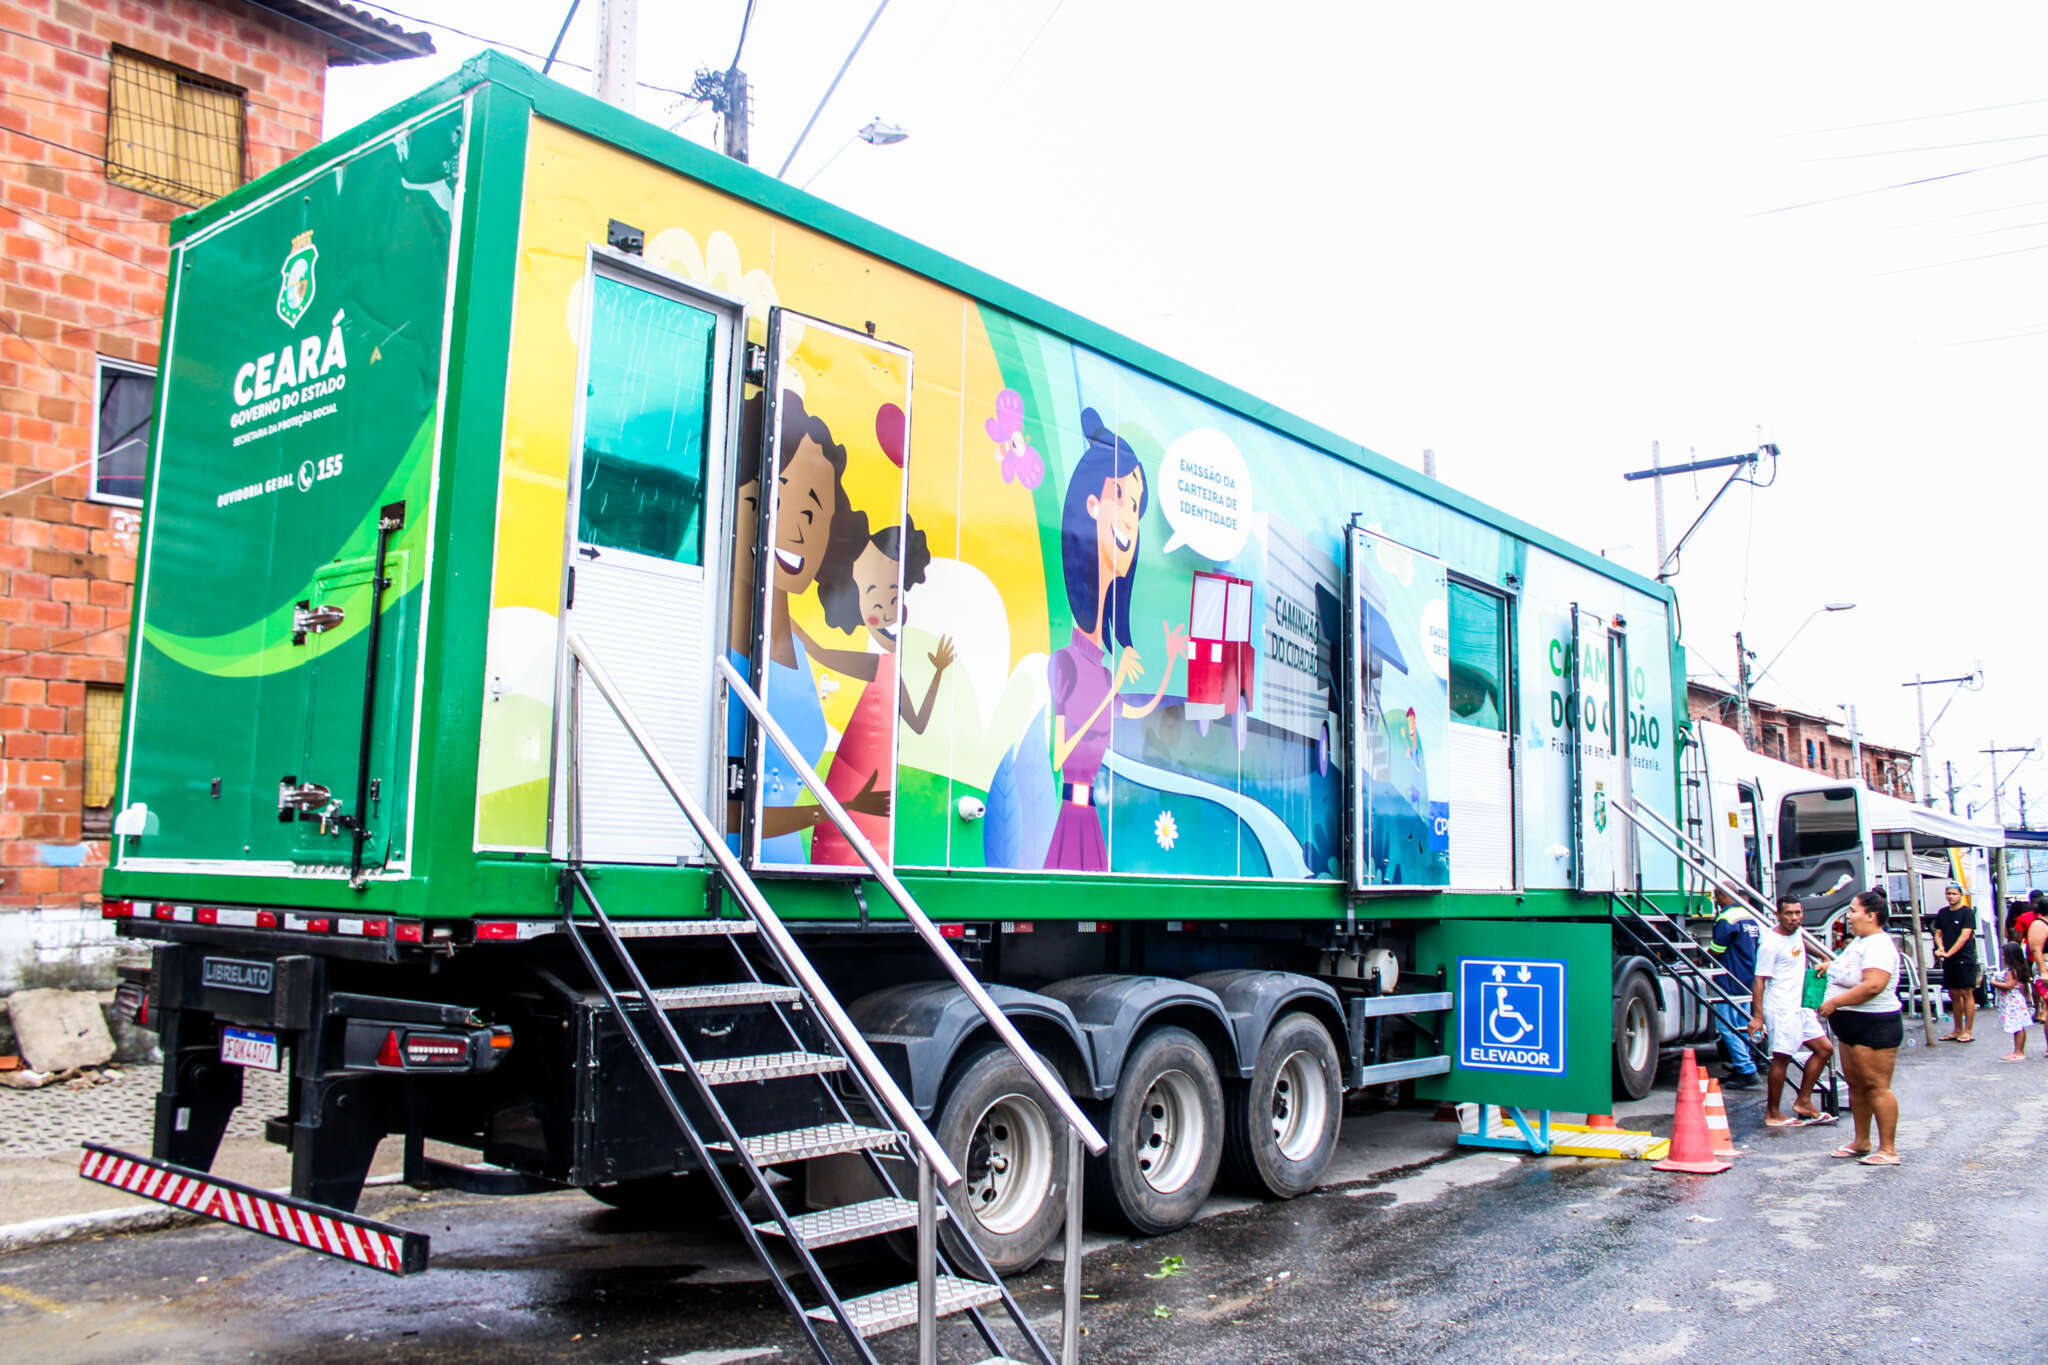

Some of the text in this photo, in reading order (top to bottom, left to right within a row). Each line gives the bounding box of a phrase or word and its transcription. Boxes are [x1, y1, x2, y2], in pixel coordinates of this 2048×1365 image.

[233, 307, 347, 407] CEARÁ
[230, 374, 345, 428] GOVERNO DO ESTADO
[232, 402, 338, 447] SECRETARIA DA PROTEÇÃO SOCIAL
[216, 453, 343, 508] OUVIDORIA GERAL 155
[1180, 459, 1221, 484] EMISSÃO
[1178, 479, 1237, 510] CARTEIRA DE
[1180, 500, 1238, 530] IDENTIDADE
[1276, 595, 1319, 645] CAMINHÃO
[1272, 632, 1319, 676] DO CIDADÃO
[205, 963, 268, 987] LIBRELATO
[1471, 1047, 1550, 1066] ELEVADOR
